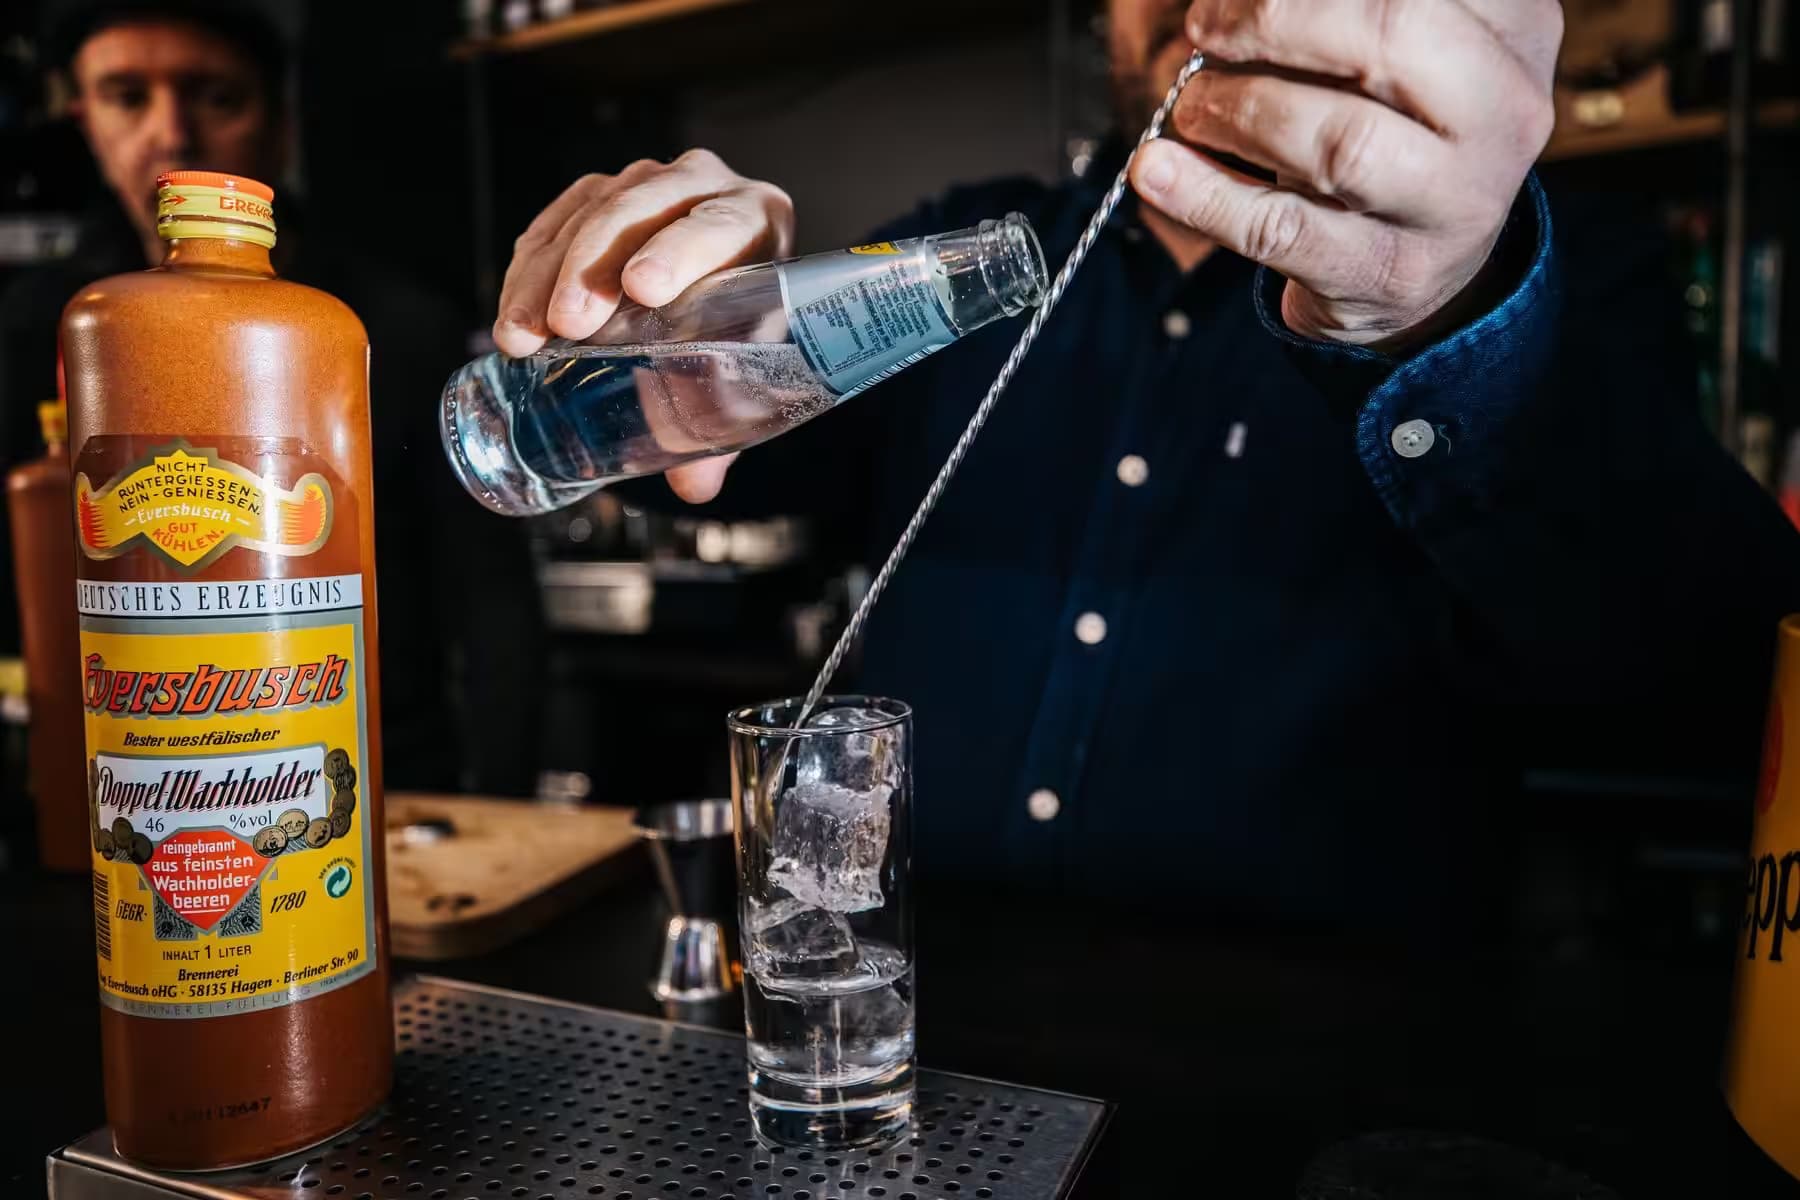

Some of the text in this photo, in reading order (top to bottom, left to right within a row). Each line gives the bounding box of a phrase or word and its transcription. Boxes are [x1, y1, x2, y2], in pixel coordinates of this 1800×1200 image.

[157, 461, 208, 473] NICHT
[118, 474, 259, 498] RUNTERGIESSEN-
[137, 502, 231, 523] Eversbusch
[168, 522, 198, 534] GUT
[152, 527, 225, 552] KÜHLEN.
[79, 579, 342, 612] DEUTSCHES ERZEUGNIS
[83, 653, 350, 717] Eversbusch
[123, 728, 280, 747] Bester westfälischer
[145, 809, 272, 833] 46 % vol
[163, 839, 236, 858] reingebrannt
[152, 855, 253, 873] aus feinsten
[152, 873, 257, 892] Wachholder-
[173, 893, 230, 908] beeren
[270, 889, 307, 914] 1780
[162, 944, 252, 961] INHALT 1 LITER
[152, 985, 177, 998] oHG
[189, 982, 227, 998] 58135
[231, 978, 273, 995] Hagen
[284, 962, 328, 984] Berliner
[330, 957, 346, 971] Str.
[347, 948, 359, 964] 90
[178, 964, 239, 982] Brennerei
